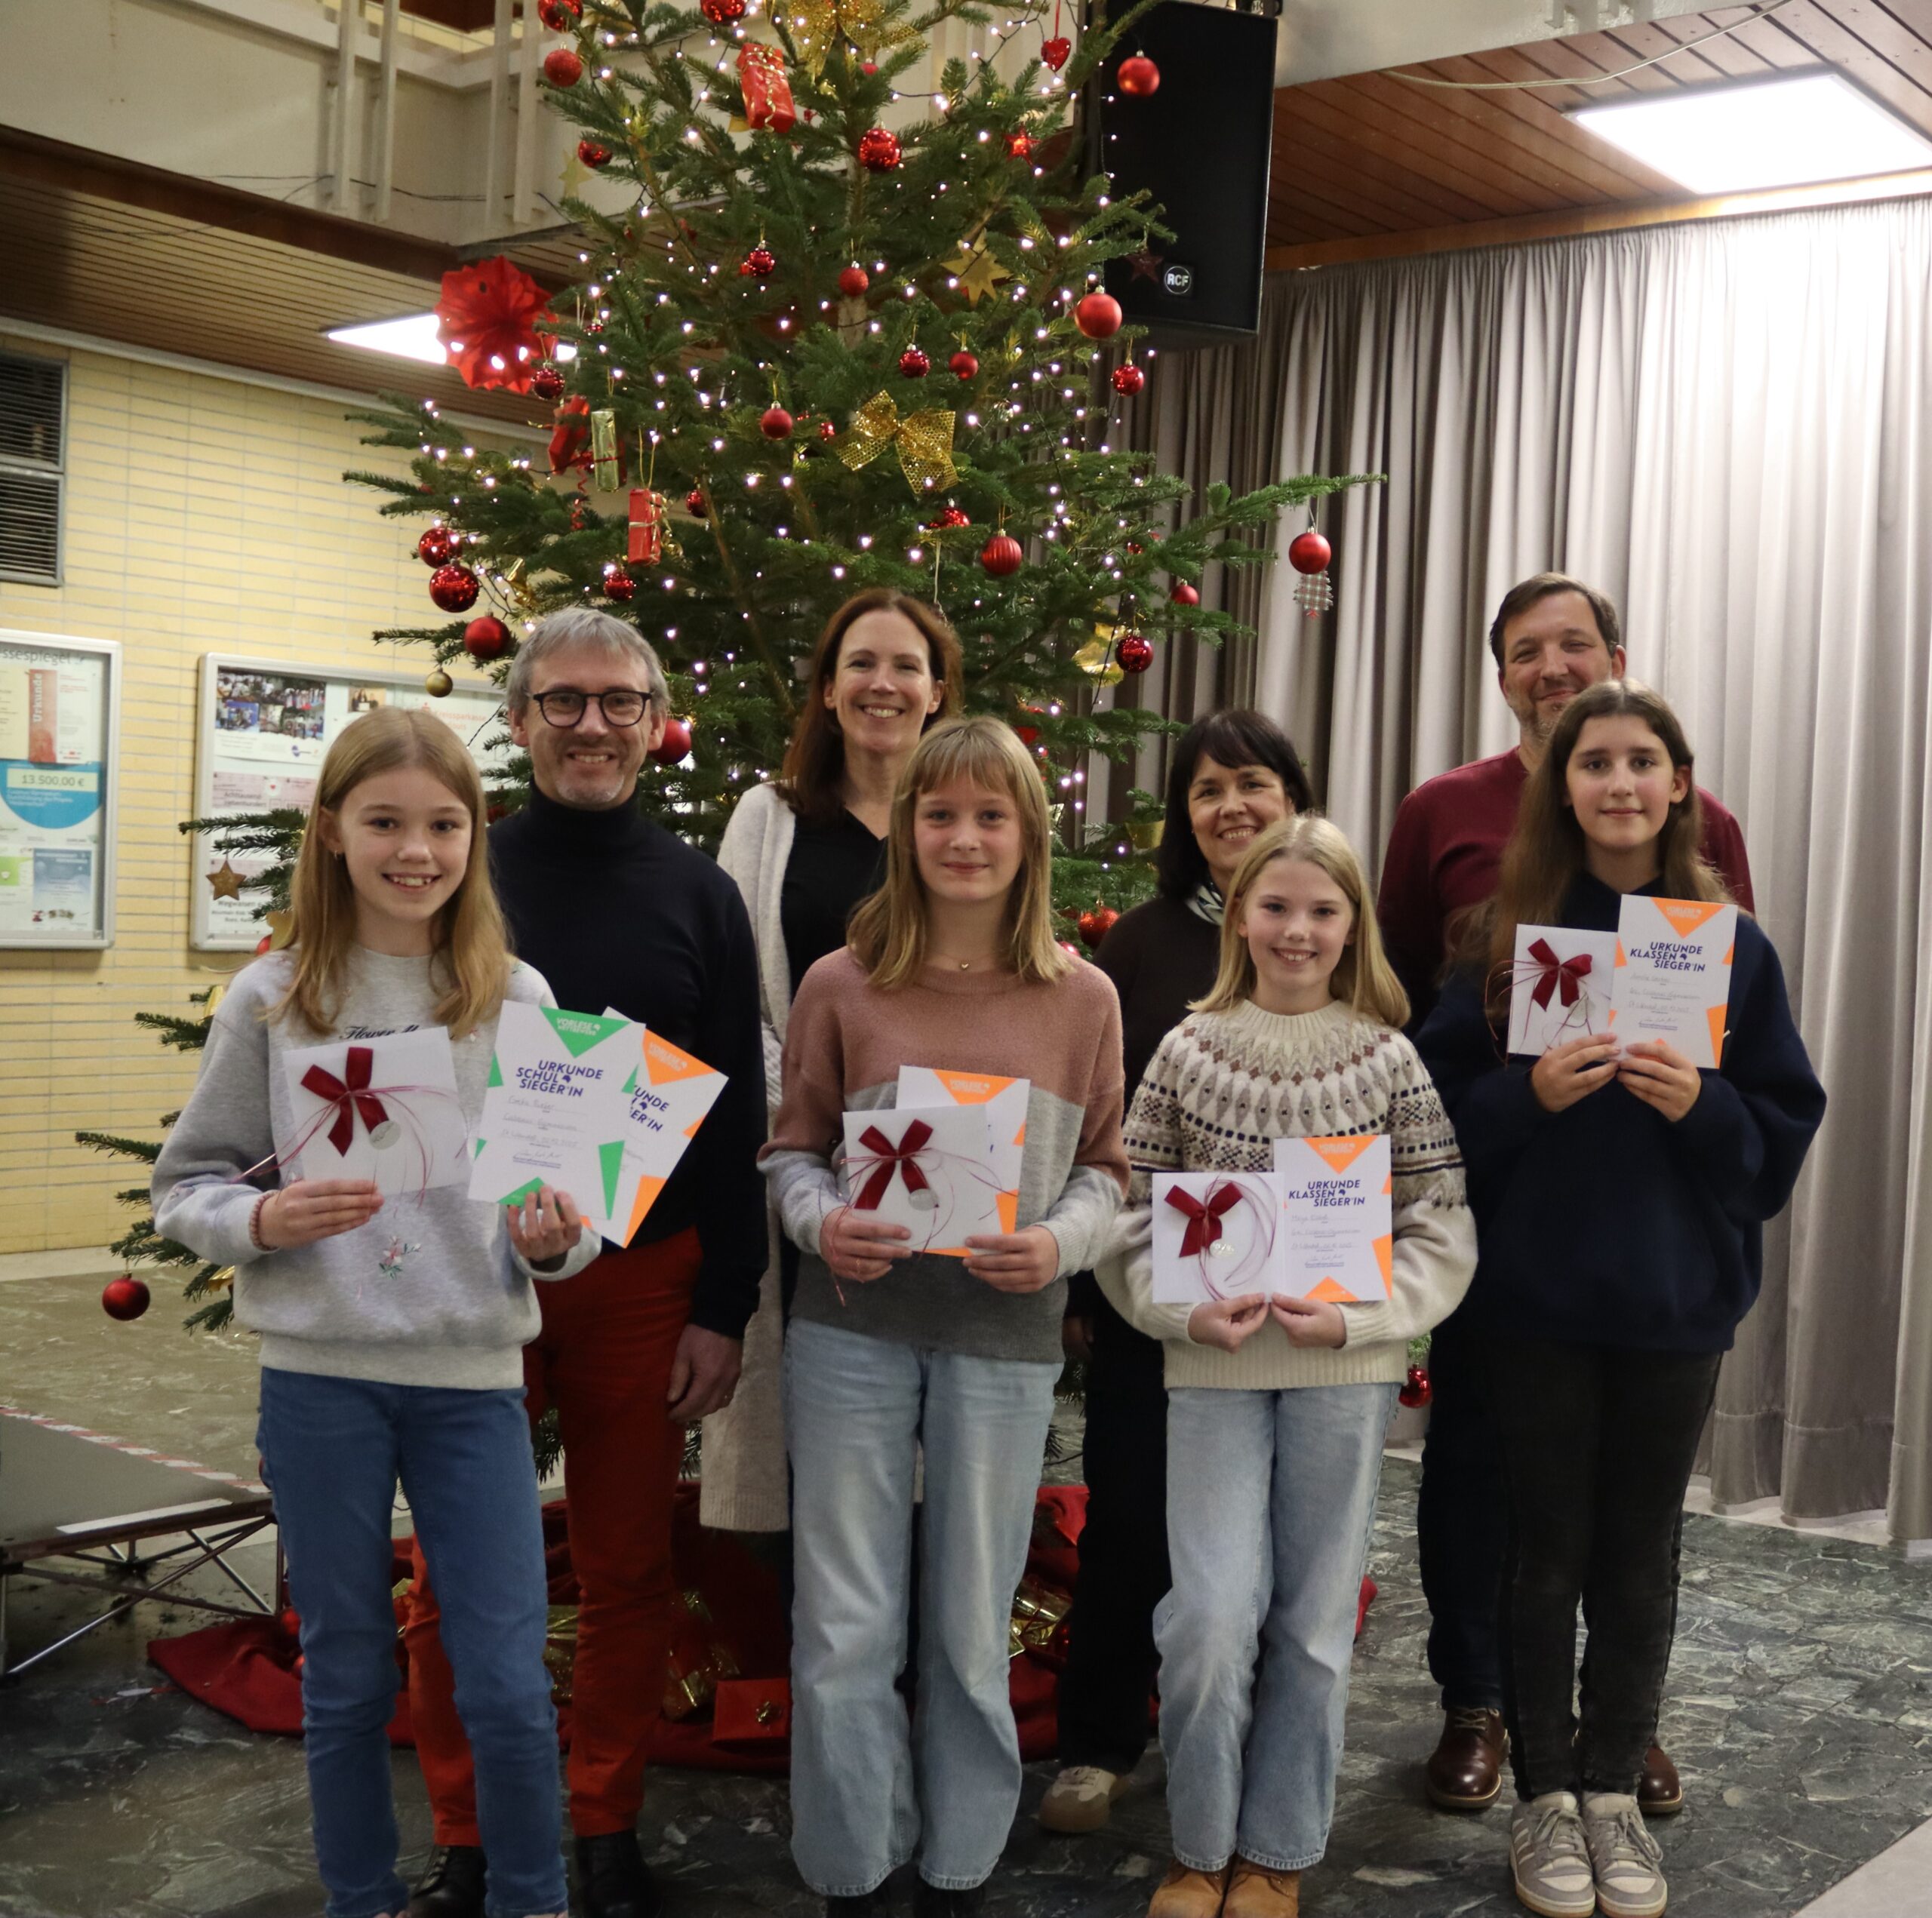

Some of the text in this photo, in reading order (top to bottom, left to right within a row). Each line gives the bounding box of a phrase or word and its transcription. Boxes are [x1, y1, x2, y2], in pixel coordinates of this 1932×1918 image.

[1167, 273, 1189, 287] RCF
[0, 648, 71, 665] ssespiegel
[1630, 948, 1677, 961] KLASSEN
[1650, 942, 1703, 955] URKUNDE
[515, 1067, 558, 1083] SCHUL
[538, 1059, 604, 1080] URKUNDE
[634, 1085, 670, 1112] UNDE
[1307, 1179, 1361, 1190] URKUNDE
[1288, 1189, 1336, 1200] KLASSEN
